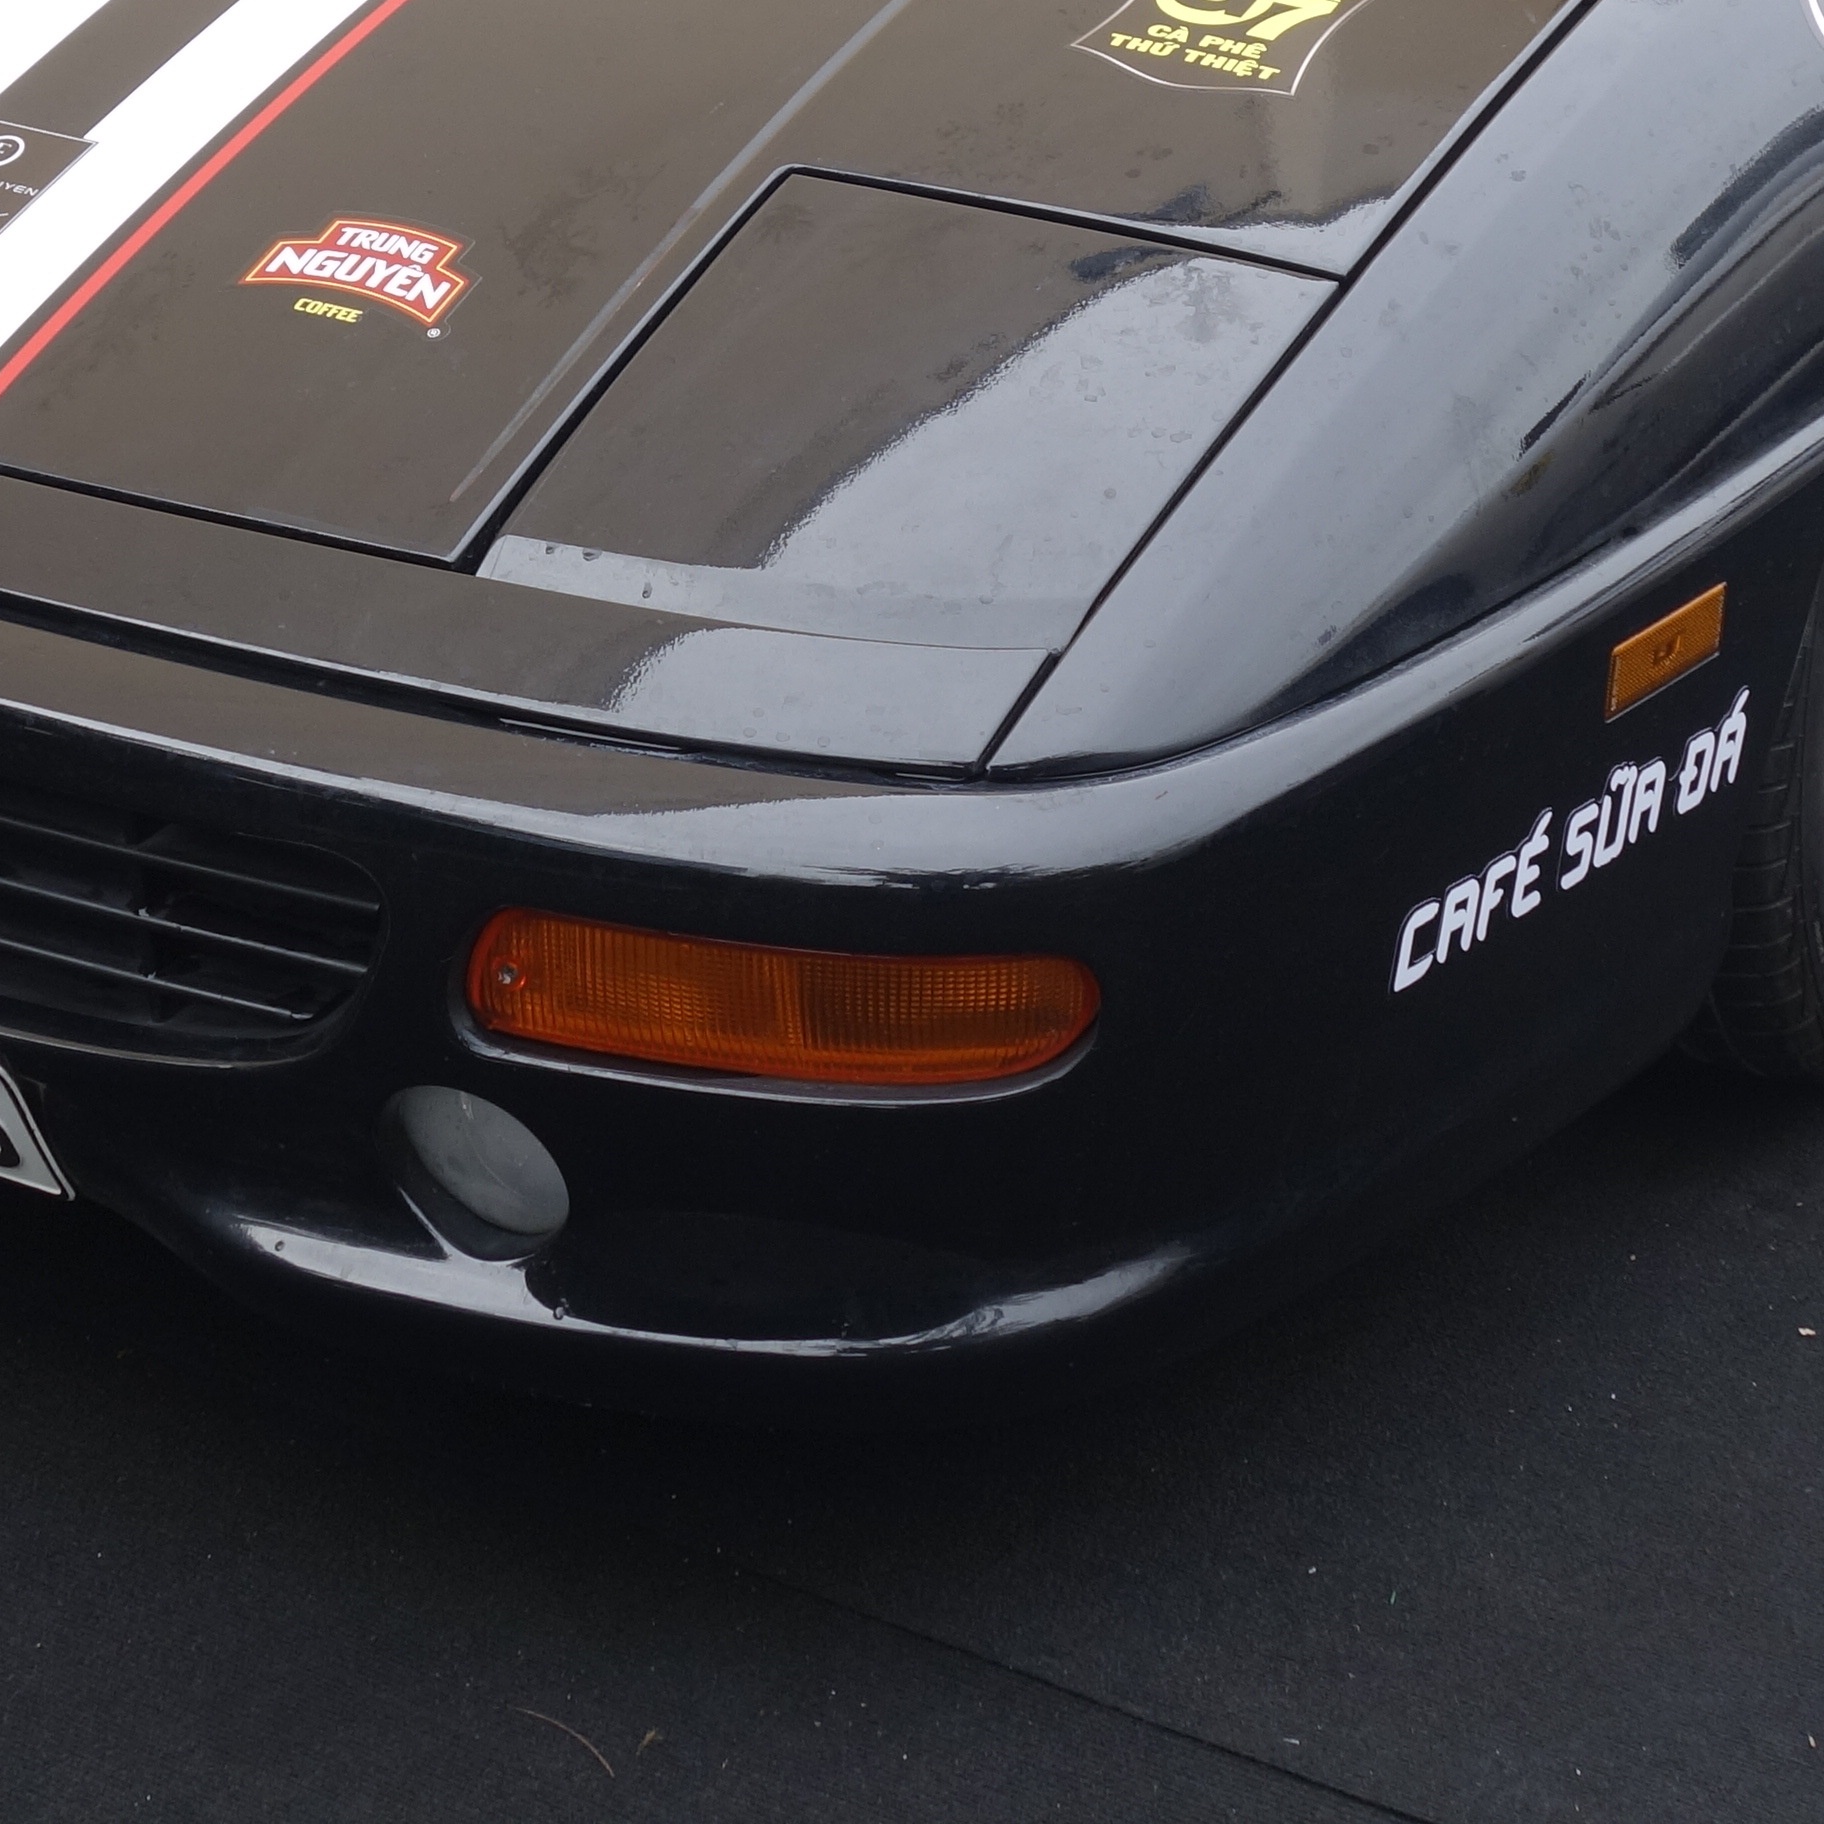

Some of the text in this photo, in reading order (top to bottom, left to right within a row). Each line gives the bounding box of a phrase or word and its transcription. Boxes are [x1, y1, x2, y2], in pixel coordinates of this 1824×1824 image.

[1147, 24, 1268, 60] CÀ PHÊ
[335, 226, 439, 264] TRUNG
[264, 245, 452, 310] NGUYÊN
[293, 297, 363, 323] COFFEE
[1393, 809, 1554, 993] CAFÉ
